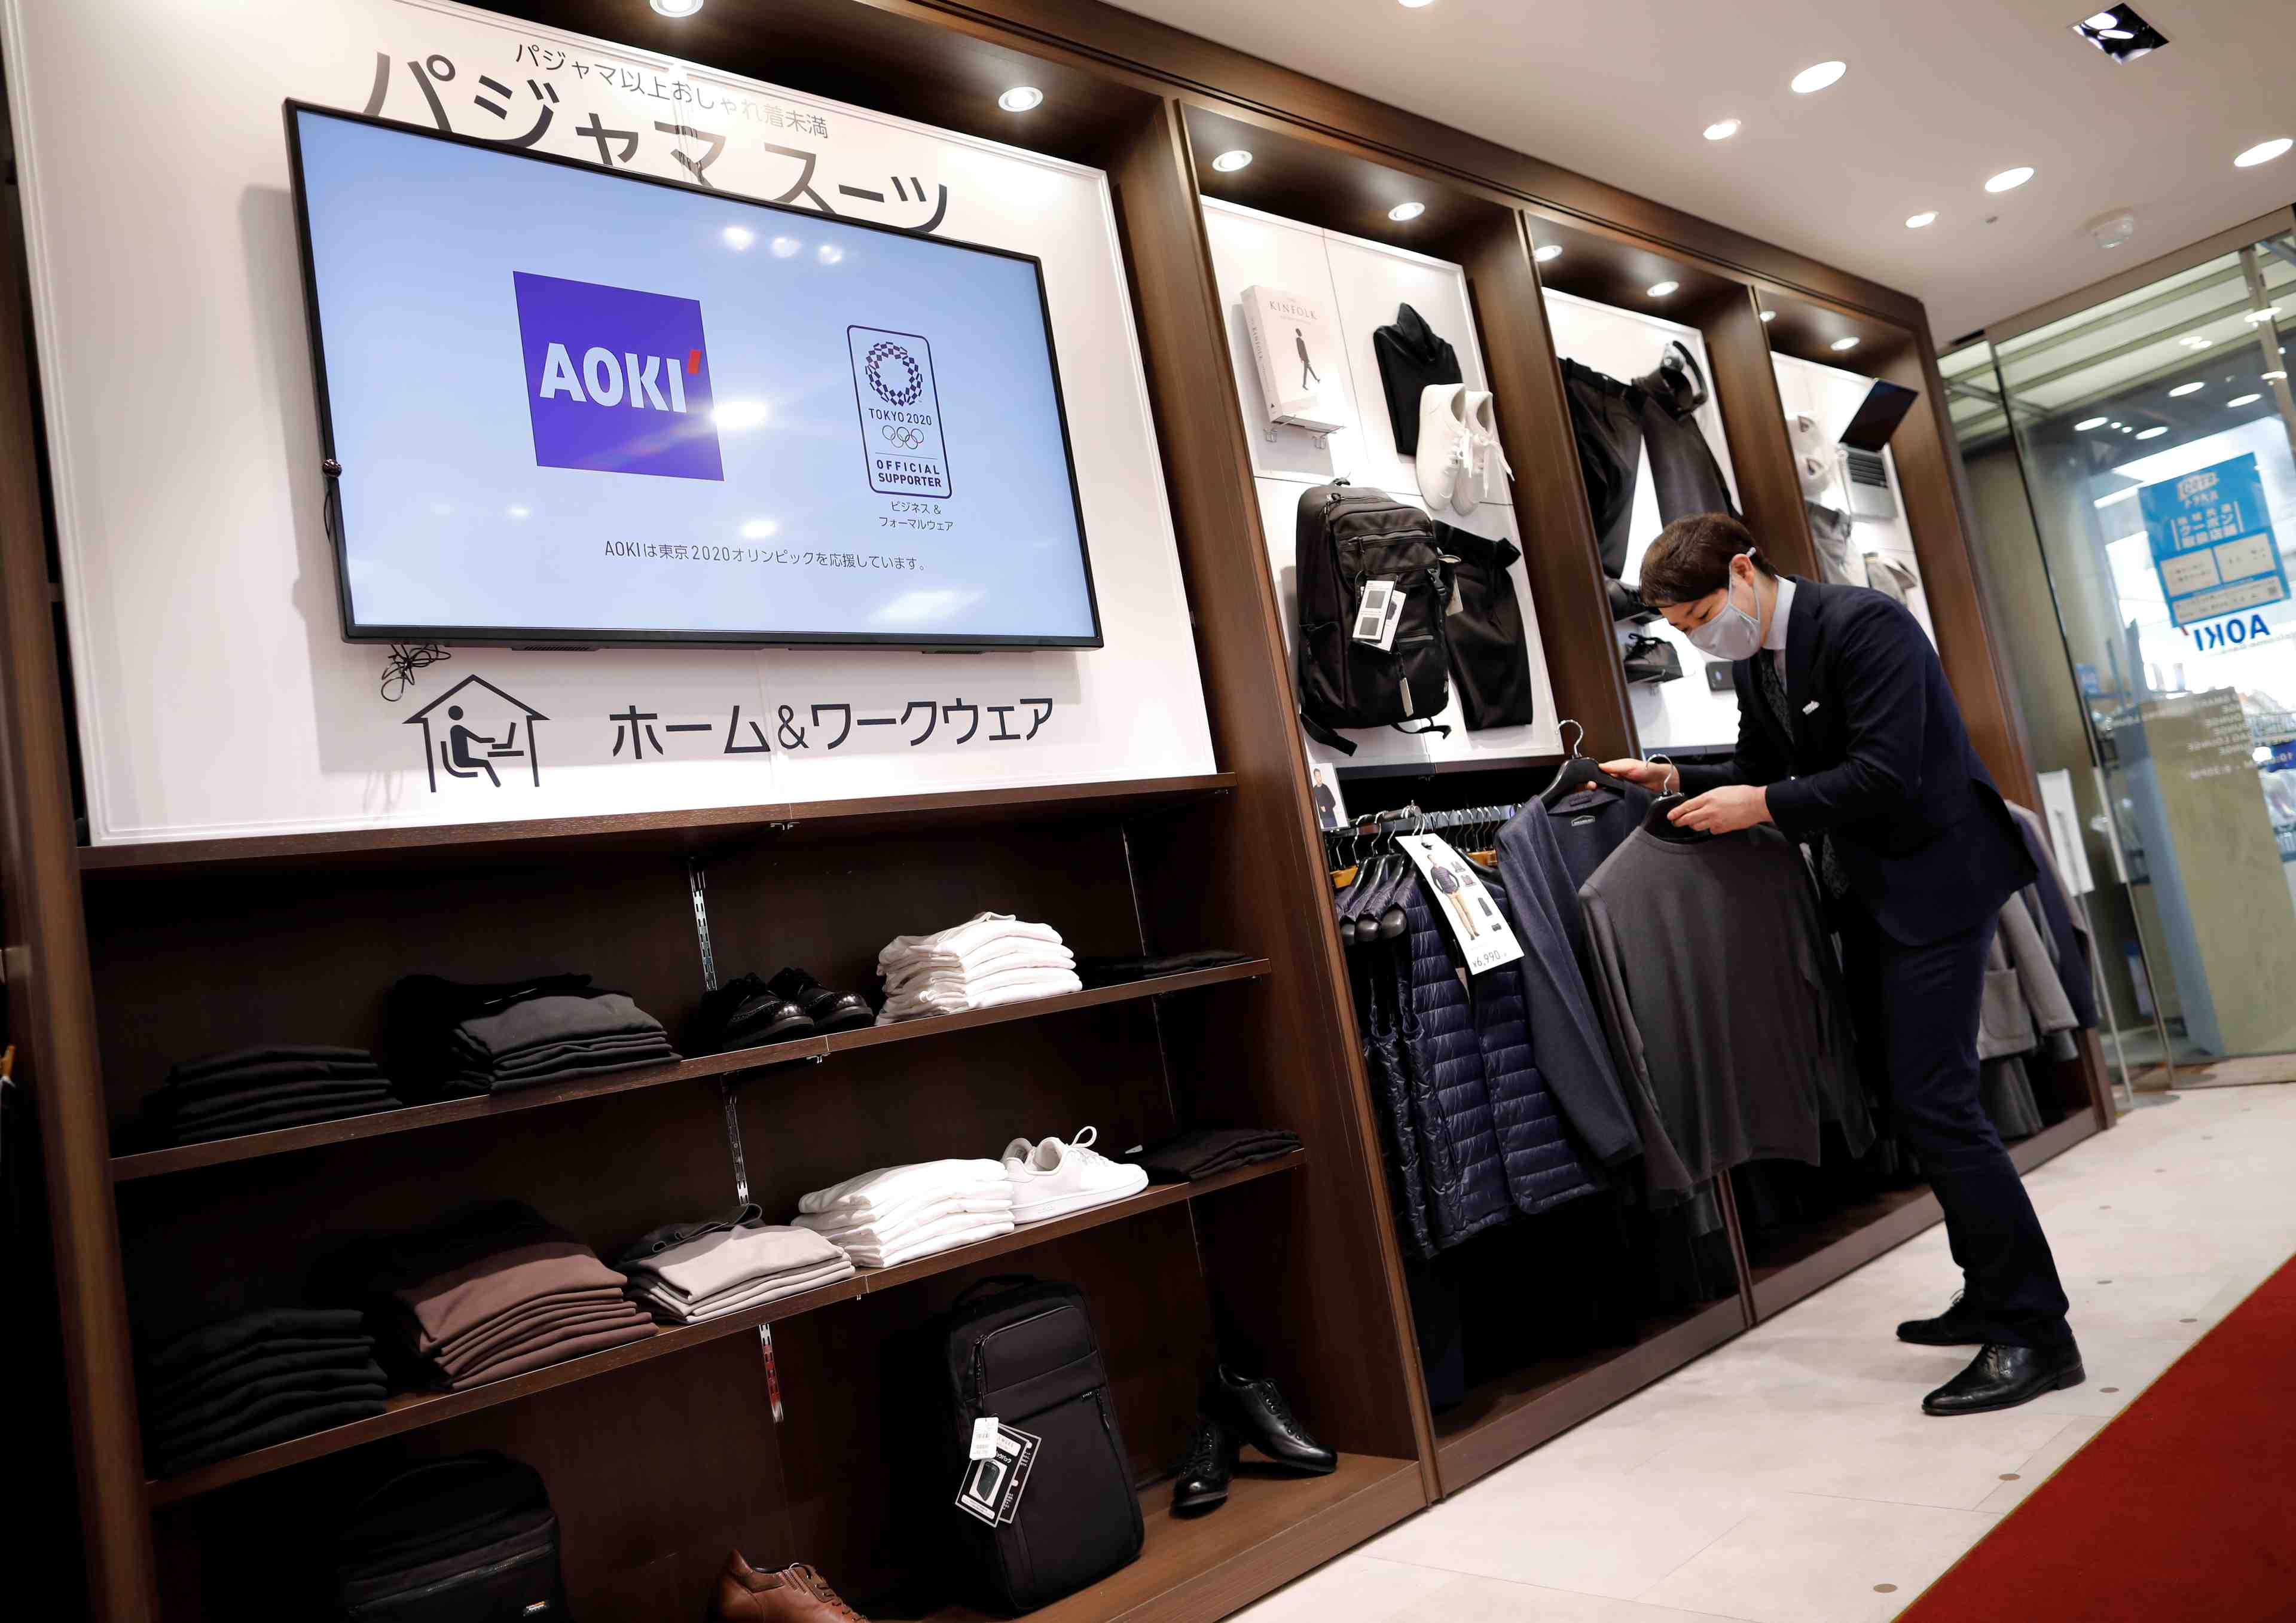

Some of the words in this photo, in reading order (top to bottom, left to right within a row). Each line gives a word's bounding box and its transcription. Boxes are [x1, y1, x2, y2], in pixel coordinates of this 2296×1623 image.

[515, 43, 828, 139] パジャマ以上おしゃれ着未満
[1269, 301, 1317, 320] KINFOLK
[868, 408, 905, 422] TOKYO
[906, 412, 932, 426] 2020
[876, 459, 940, 475] OFFICIAL
[878, 472, 942, 488] SUPPORTER
[890, 501, 930, 515] ビジネス
[879, 516, 954, 531] フォーマルウェア
